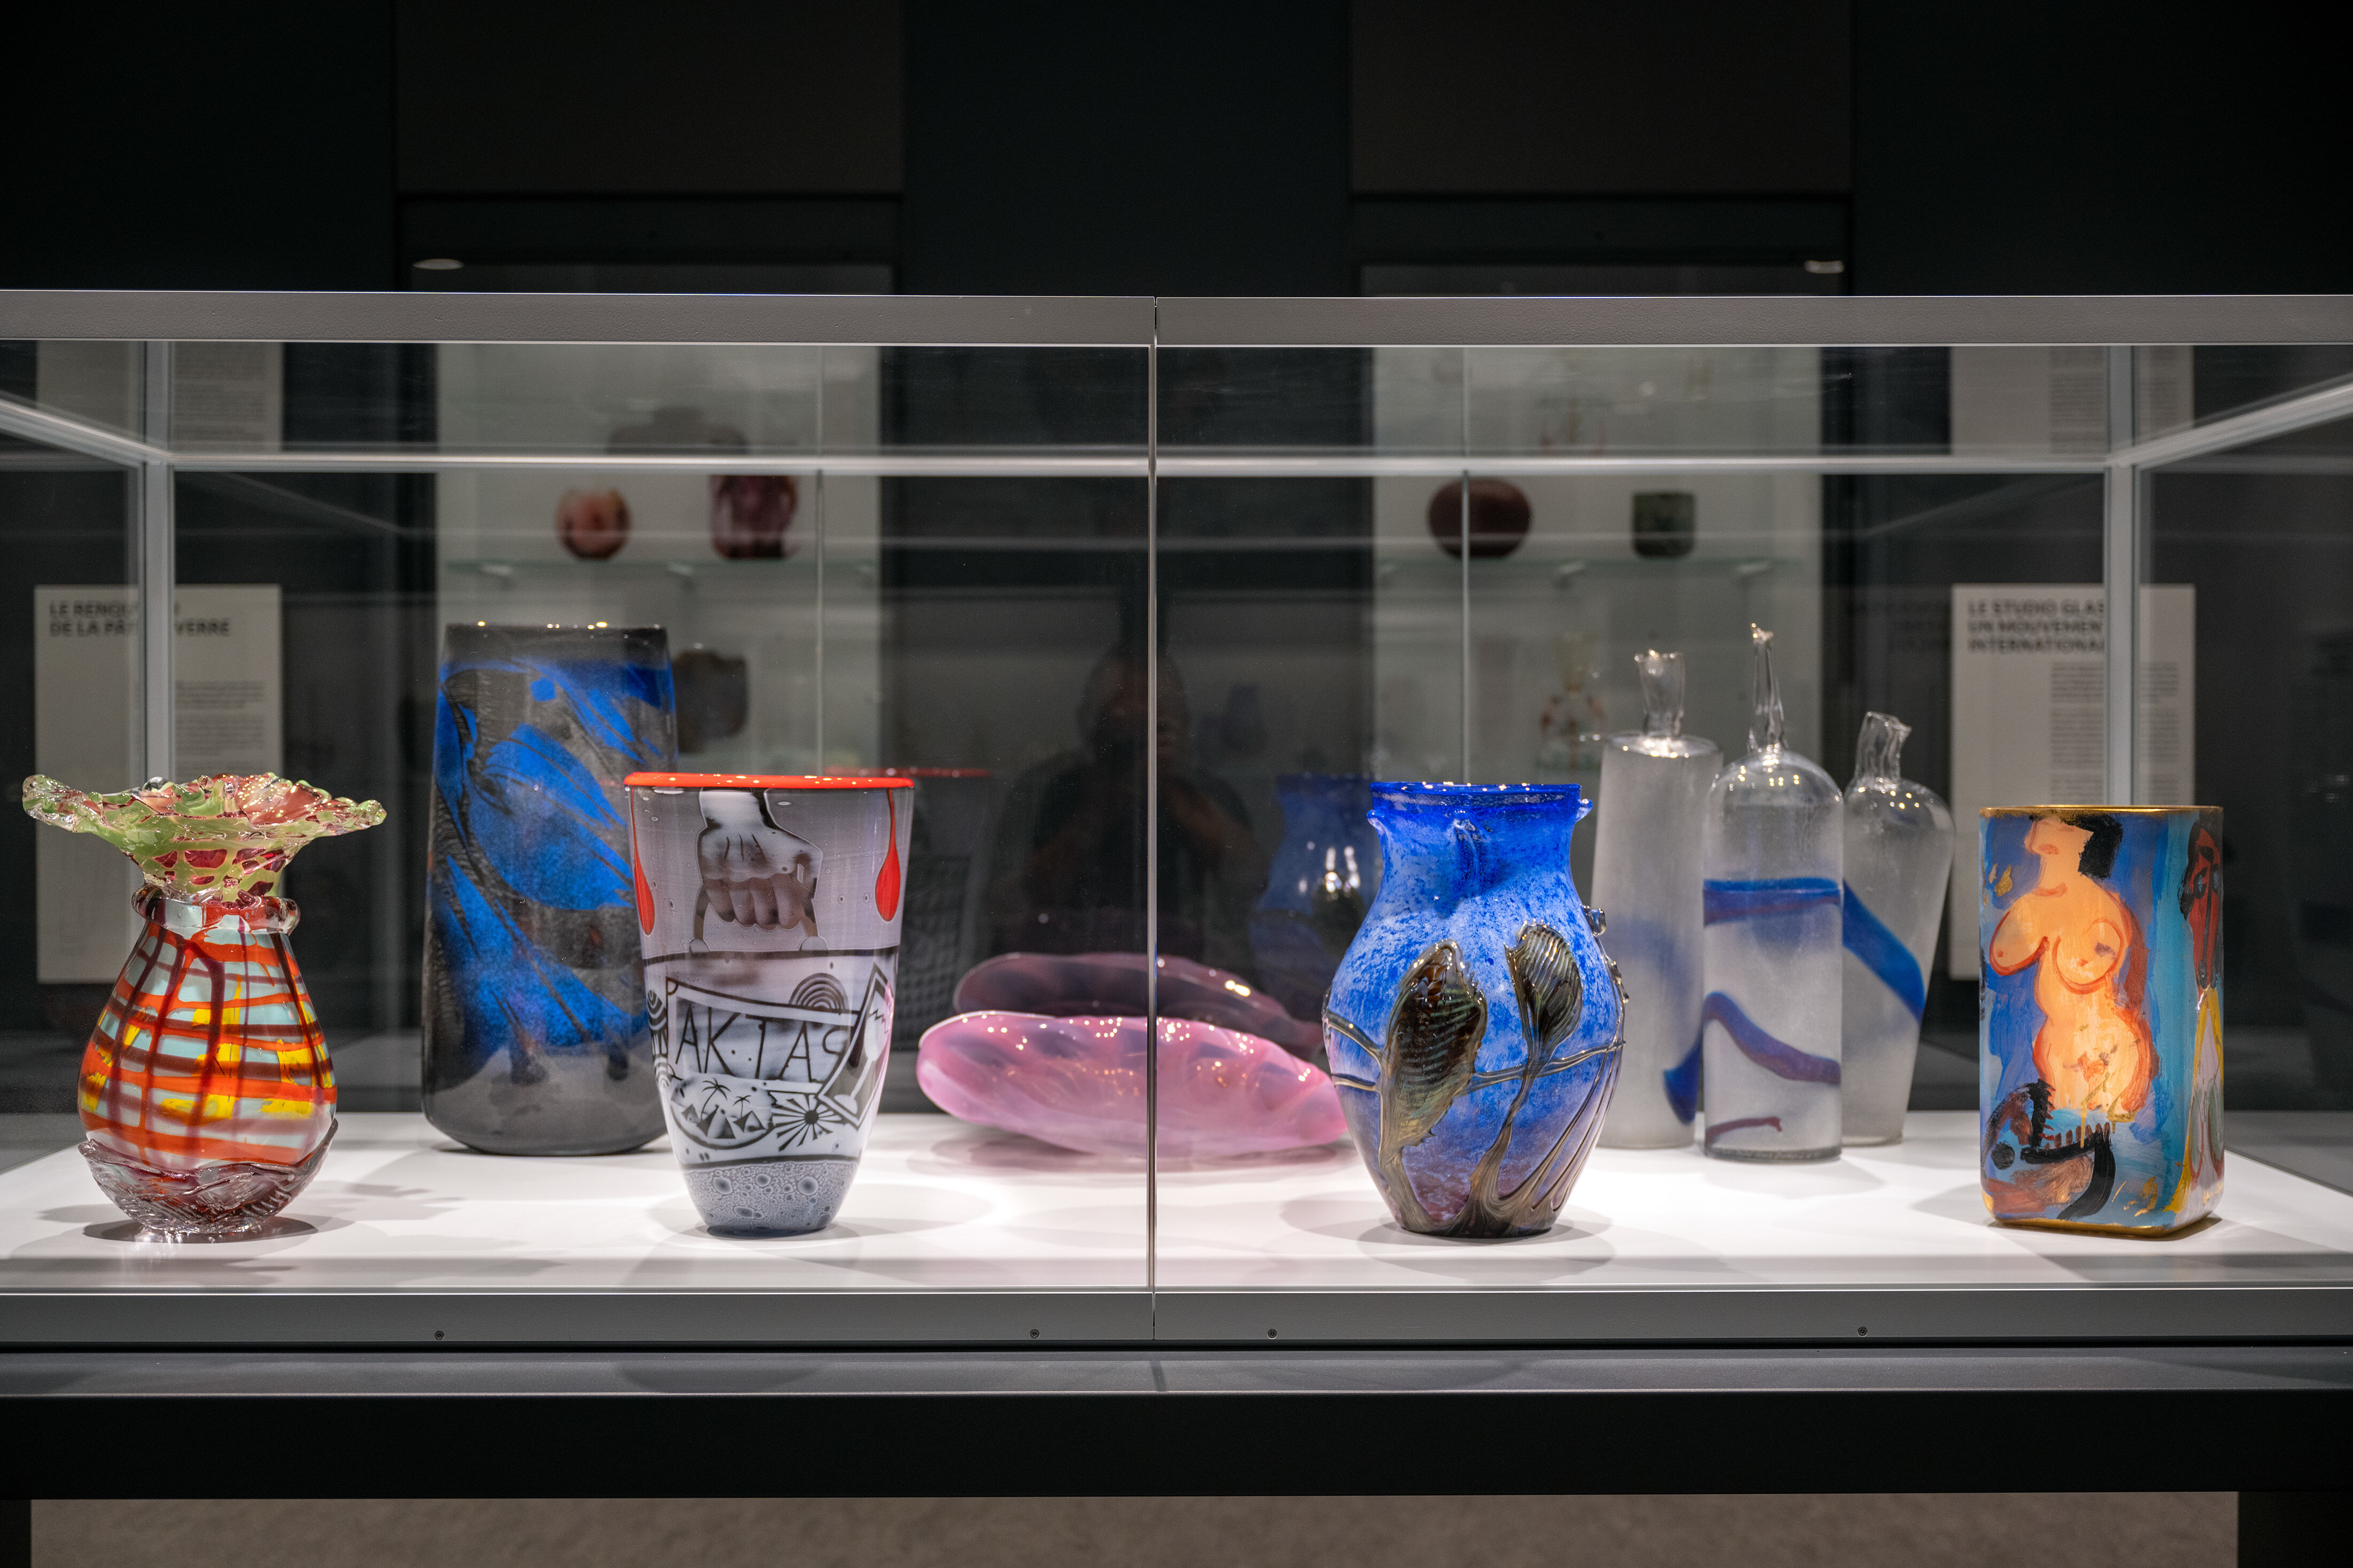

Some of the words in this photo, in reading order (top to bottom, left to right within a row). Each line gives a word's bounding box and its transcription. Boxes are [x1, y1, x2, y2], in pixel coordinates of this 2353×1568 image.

[49, 600, 68, 615] LE
[1968, 600, 1986, 615] LE
[1991, 599, 2058, 615] STUDIO
[49, 620, 71, 636] DE
[77, 620, 99, 636] LA
